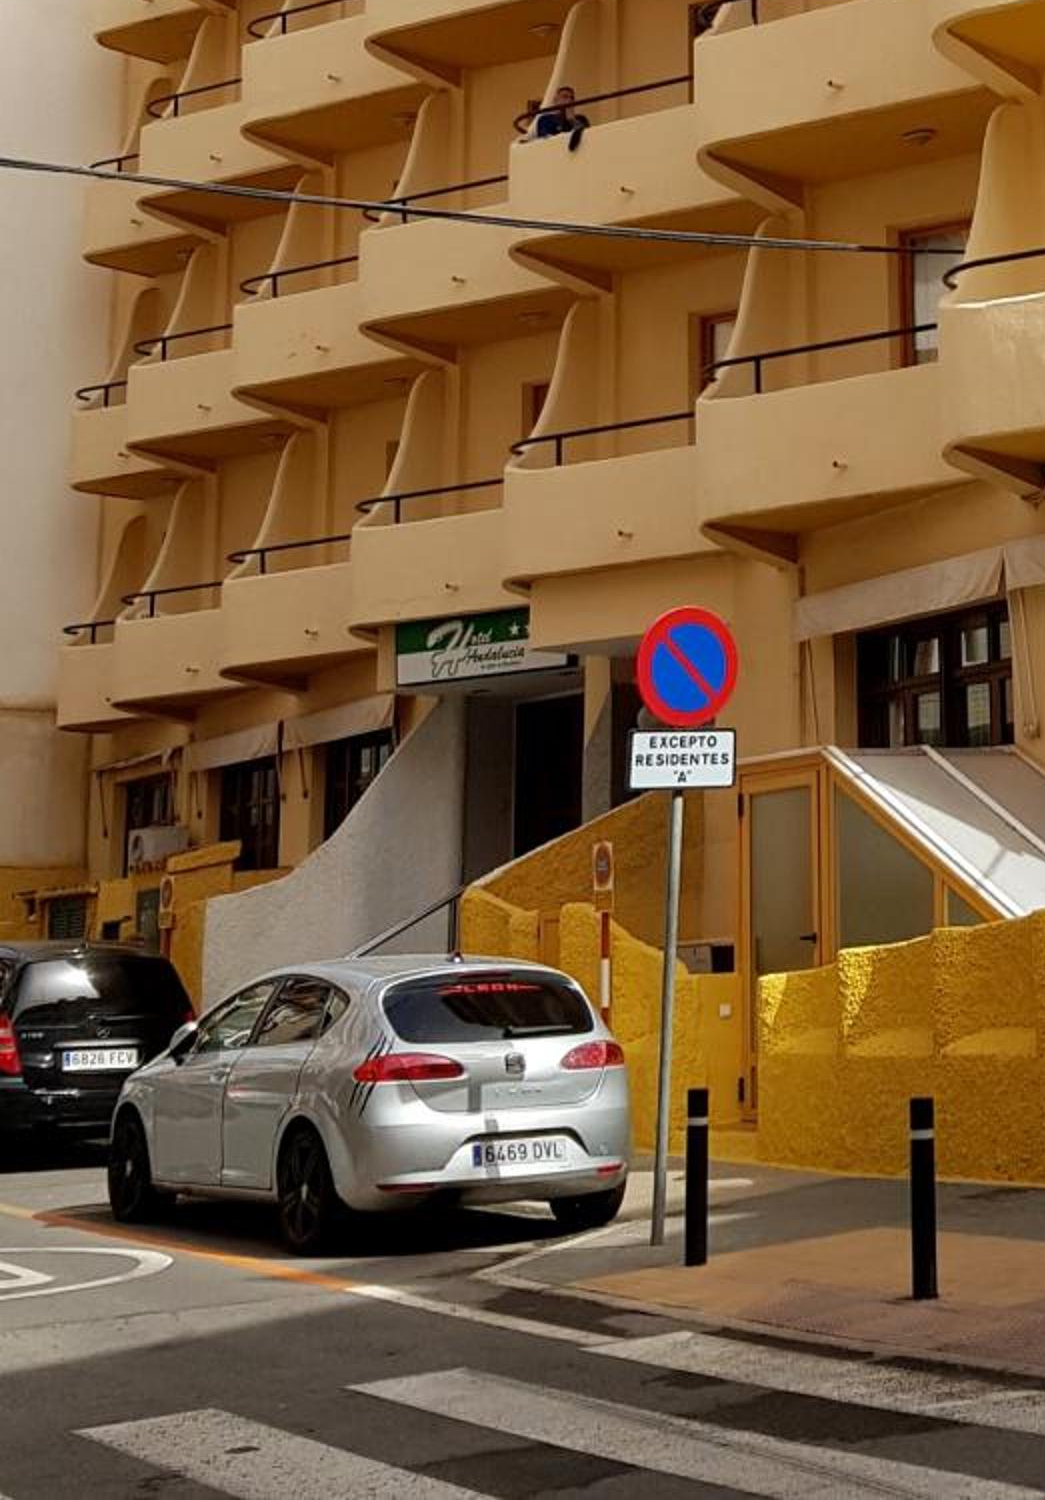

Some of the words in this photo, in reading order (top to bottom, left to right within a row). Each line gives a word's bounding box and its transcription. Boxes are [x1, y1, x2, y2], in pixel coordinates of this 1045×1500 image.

[649, 735, 717, 749] EXCEPTO
[635, 753, 729, 767] RESIDENTES
[485, 1143, 528, 1163] 6469
[532, 1141, 563, 1159] DVL
